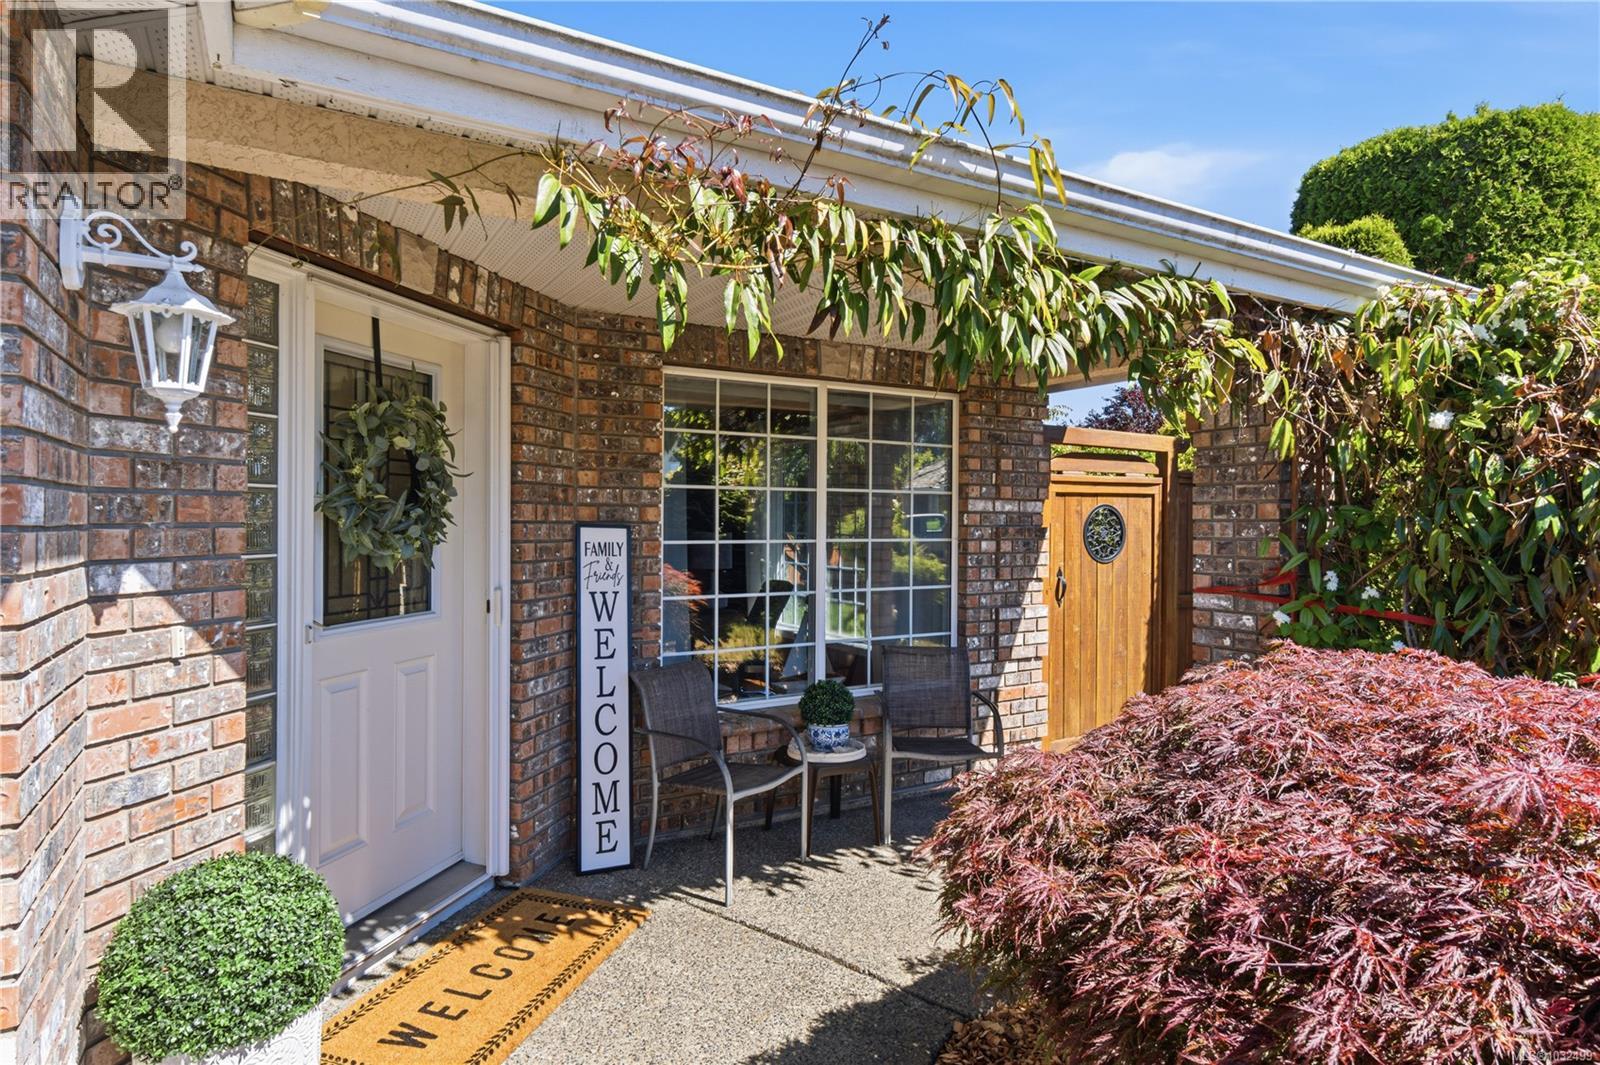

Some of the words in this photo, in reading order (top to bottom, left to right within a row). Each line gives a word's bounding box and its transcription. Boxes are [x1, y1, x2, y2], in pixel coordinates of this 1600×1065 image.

[584, 541, 624, 557] FAMILY
[583, 560, 624, 590] Friends
[605, 557, 614, 572] &
[589, 591, 620, 855] WELCOME
[377, 912, 577, 1050] WELCOME
